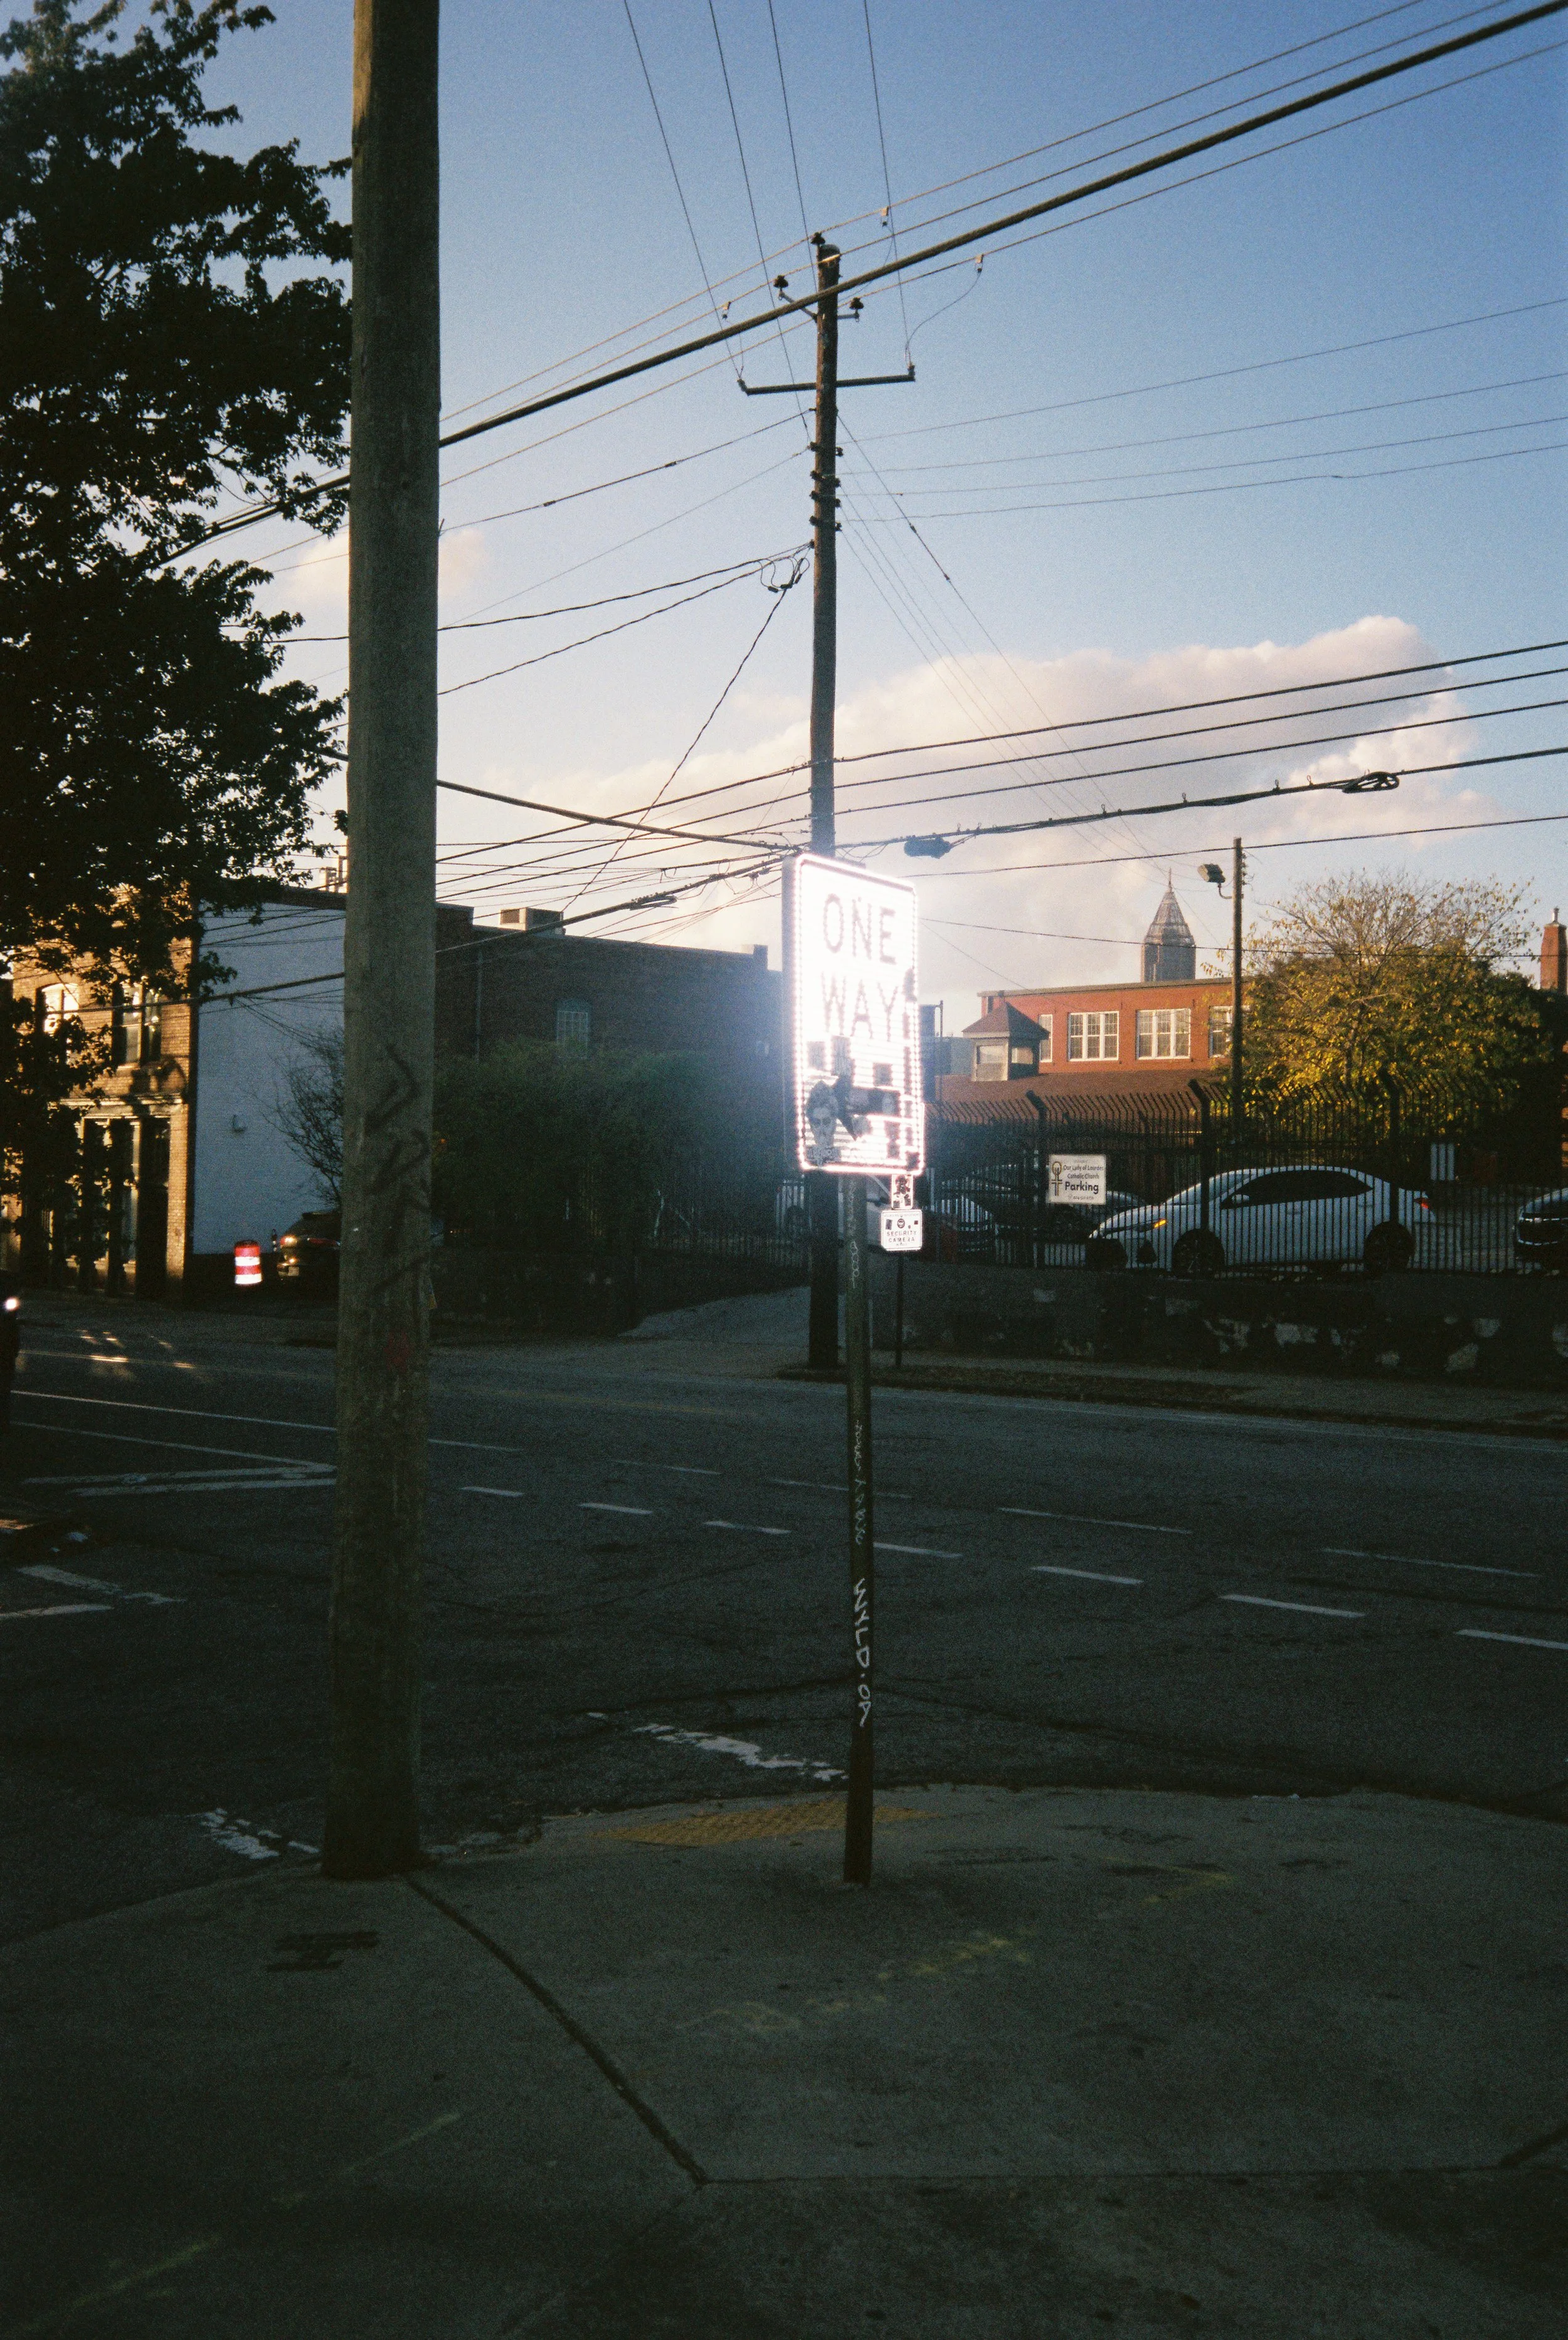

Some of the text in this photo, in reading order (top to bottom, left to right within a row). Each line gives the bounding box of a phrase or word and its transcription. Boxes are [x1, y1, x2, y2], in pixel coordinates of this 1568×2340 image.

[823, 892, 897, 965] ONE
[821, 971, 899, 1042] WAY
[1065, 1180, 1099, 1195] Parking
